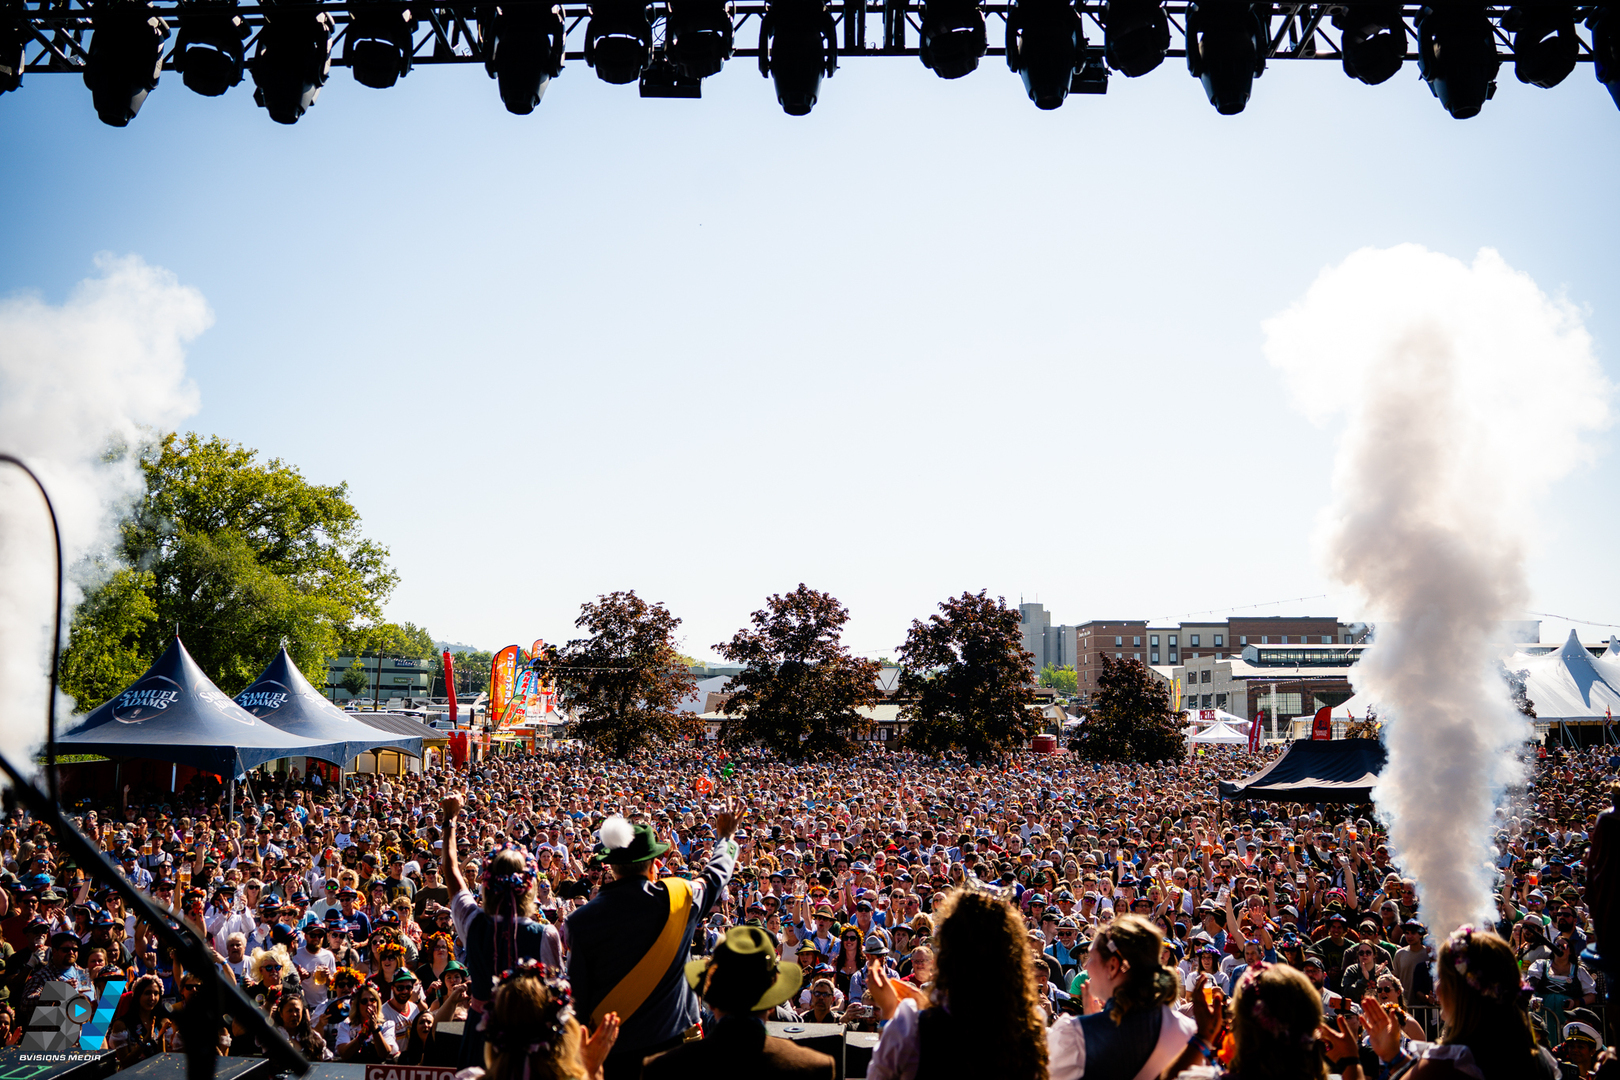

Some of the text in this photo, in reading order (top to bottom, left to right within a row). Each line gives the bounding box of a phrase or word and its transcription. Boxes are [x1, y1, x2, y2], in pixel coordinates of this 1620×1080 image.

[120, 689, 179, 702] SAMUEL
[239, 691, 288, 703] SAMUEL
[116, 699, 170, 709] ADAMS
[239, 698, 281, 709] ADAMS
[369, 1068, 455, 1080] CAUTIO
